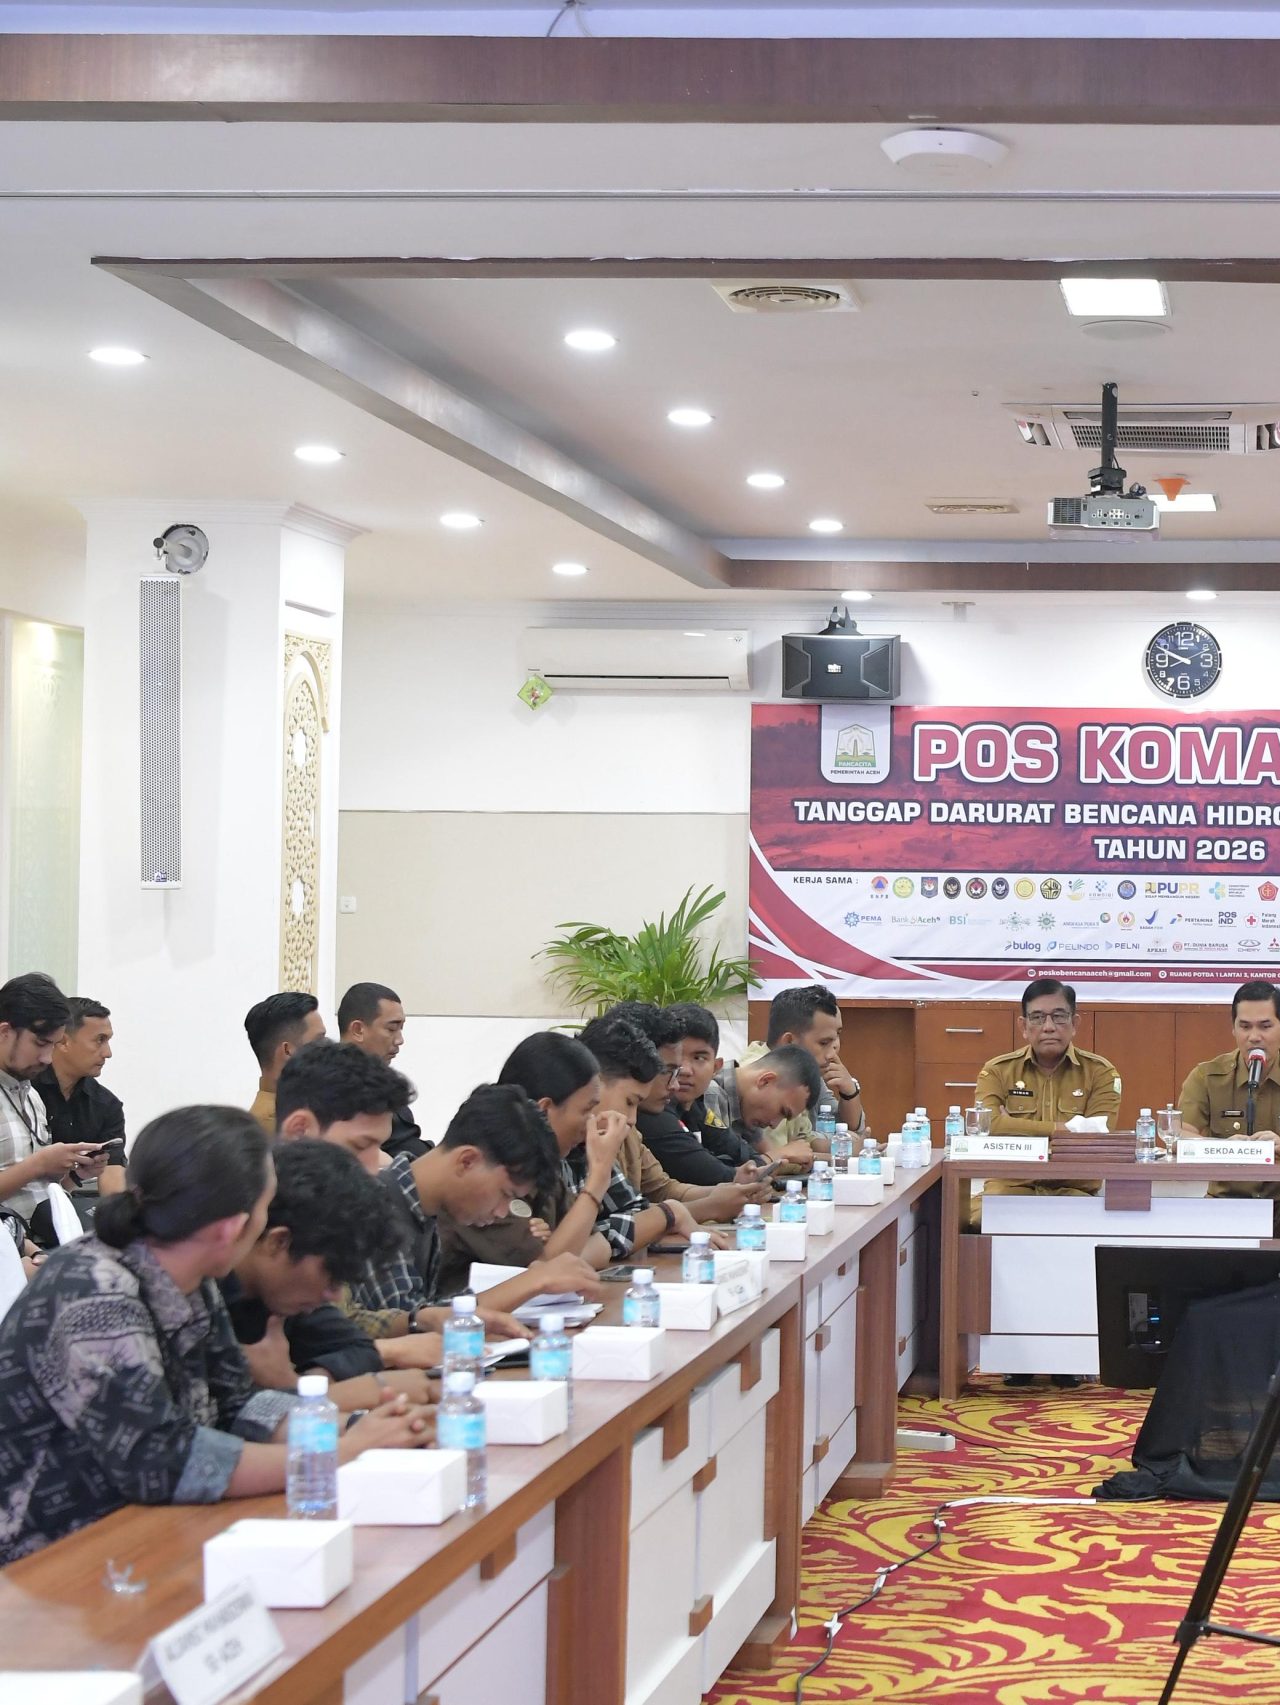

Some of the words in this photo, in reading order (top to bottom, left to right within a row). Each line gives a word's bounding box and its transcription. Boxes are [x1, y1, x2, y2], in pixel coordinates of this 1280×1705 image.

[1175, 631, 1194, 646] 12
[1156, 653, 1168, 668] 9
[1200, 653, 1213, 668] 3
[1177, 675, 1190, 690] 6
[914, 724, 1058, 783] POS
[794, 801, 921, 822] TANGGAP
[931, 803, 1055, 823] DARURAT
[1065, 804, 1197, 826] BENCANA
[1094, 838, 1186, 860] TAHUN
[1196, 840, 1266, 861] 2026
[793, 876, 822, 884] KERJA
[825, 876, 852, 884] SAMA
[891, 916, 909, 924] Bank
[918, 915, 936, 924] Aceh
[949, 915, 966, 925] BSI
[1013, 941, 1041, 952] bulog
[1059, 943, 1100, 951] PELINDO
[1115, 942, 1140, 950] PELNI
[1039, 969, 1152, 978] poskobencanaaceh@gmail.com
[983, 1143, 1021, 1151] ASISTEN
[1204, 1147, 1235, 1155] SEKDA
